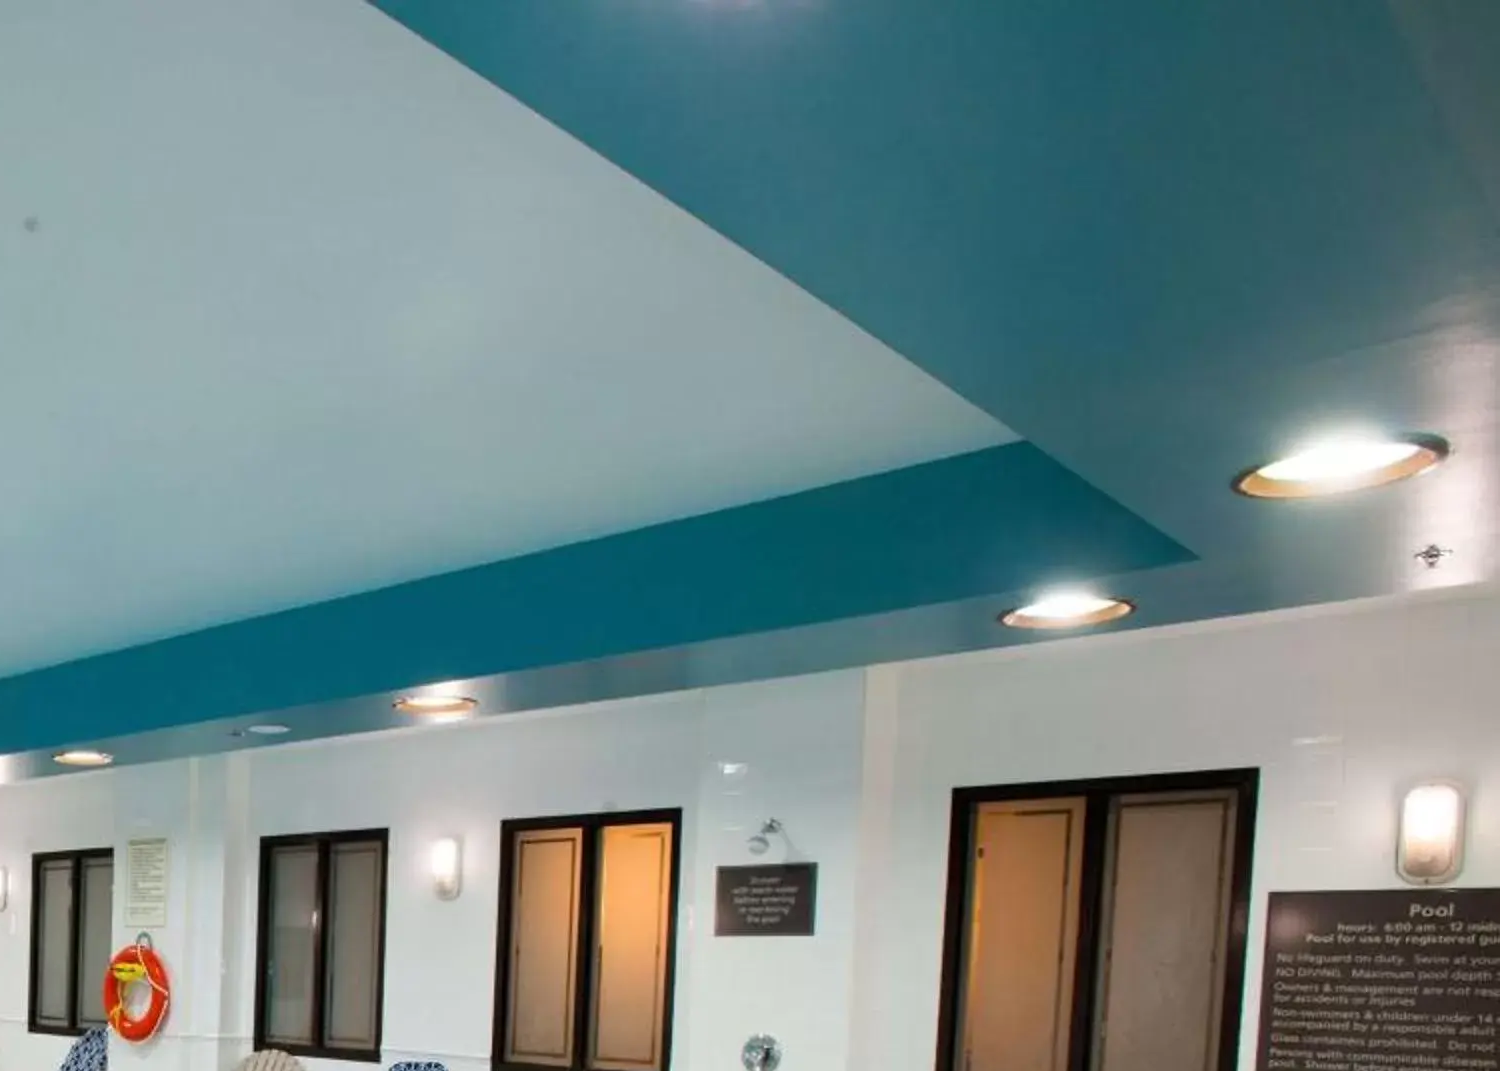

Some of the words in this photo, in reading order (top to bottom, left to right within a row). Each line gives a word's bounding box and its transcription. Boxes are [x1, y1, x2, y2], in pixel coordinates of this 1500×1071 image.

[1409, 902, 1455, 917] Pool
[1305, 933, 1335, 944] Pool
[1337, 933, 1356, 944] for
[1359, 935, 1381, 944] use
[1385, 934, 1401, 946] by
[1405, 934, 1475, 947] registered
[1354, 955, 1371, 963] on
[1413, 953, 1449, 965] Swim
[1452, 955, 1467, 965] at
[1275, 967, 1295, 977] NO
[1351, 968, 1415, 979] Maximum
[1417, 968, 1448, 981] pool
[1450, 970, 1492, 982] depth
[1274, 981, 1318, 992] Owners
[1335, 984, 1418, 996] management
[1422, 987, 1444, 996] are
[1447, 986, 1471, 996] not
[1432, 1012, 1475, 1023] under
[1477, 1013, 1493, 1024] 14
[1353, 1021, 1368, 1033] by
[1382, 1024, 1456, 1036] responsible
[1447, 1040, 1467, 1052] Do
[1471, 1041, 1495, 1053] not
[1315, 1050, 1343, 1060] with
[1304, 1060, 1350, 1071] Shower
